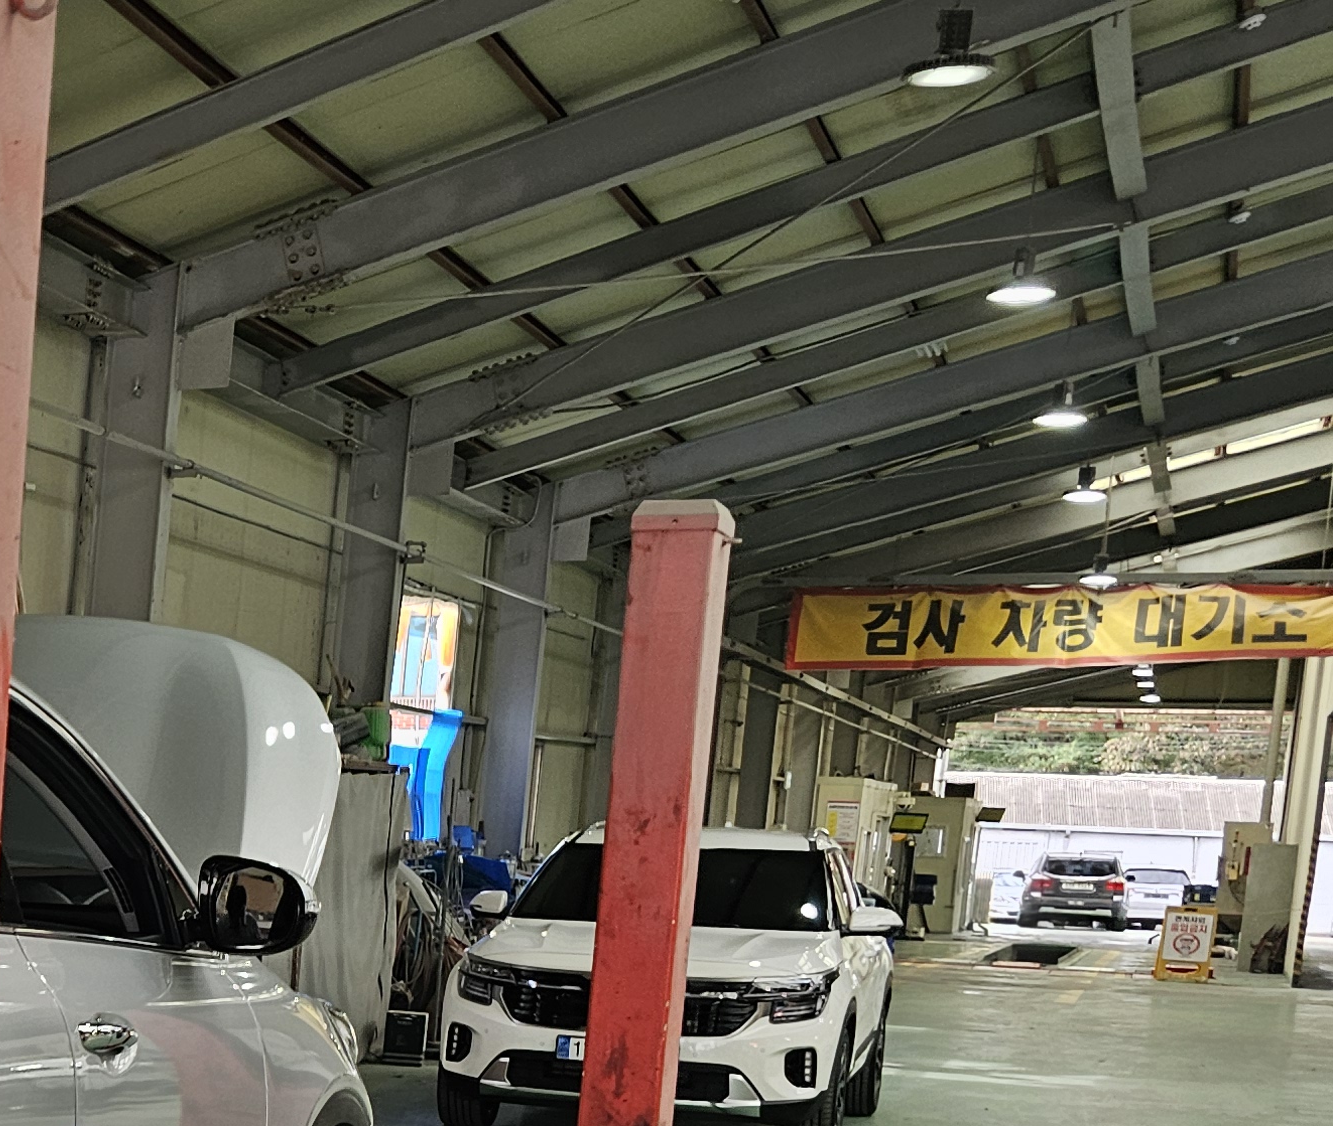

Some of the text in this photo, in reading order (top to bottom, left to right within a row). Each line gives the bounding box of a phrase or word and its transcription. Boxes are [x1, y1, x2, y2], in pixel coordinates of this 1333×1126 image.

[862, 594, 1309, 655] 검사 차량 대기소
